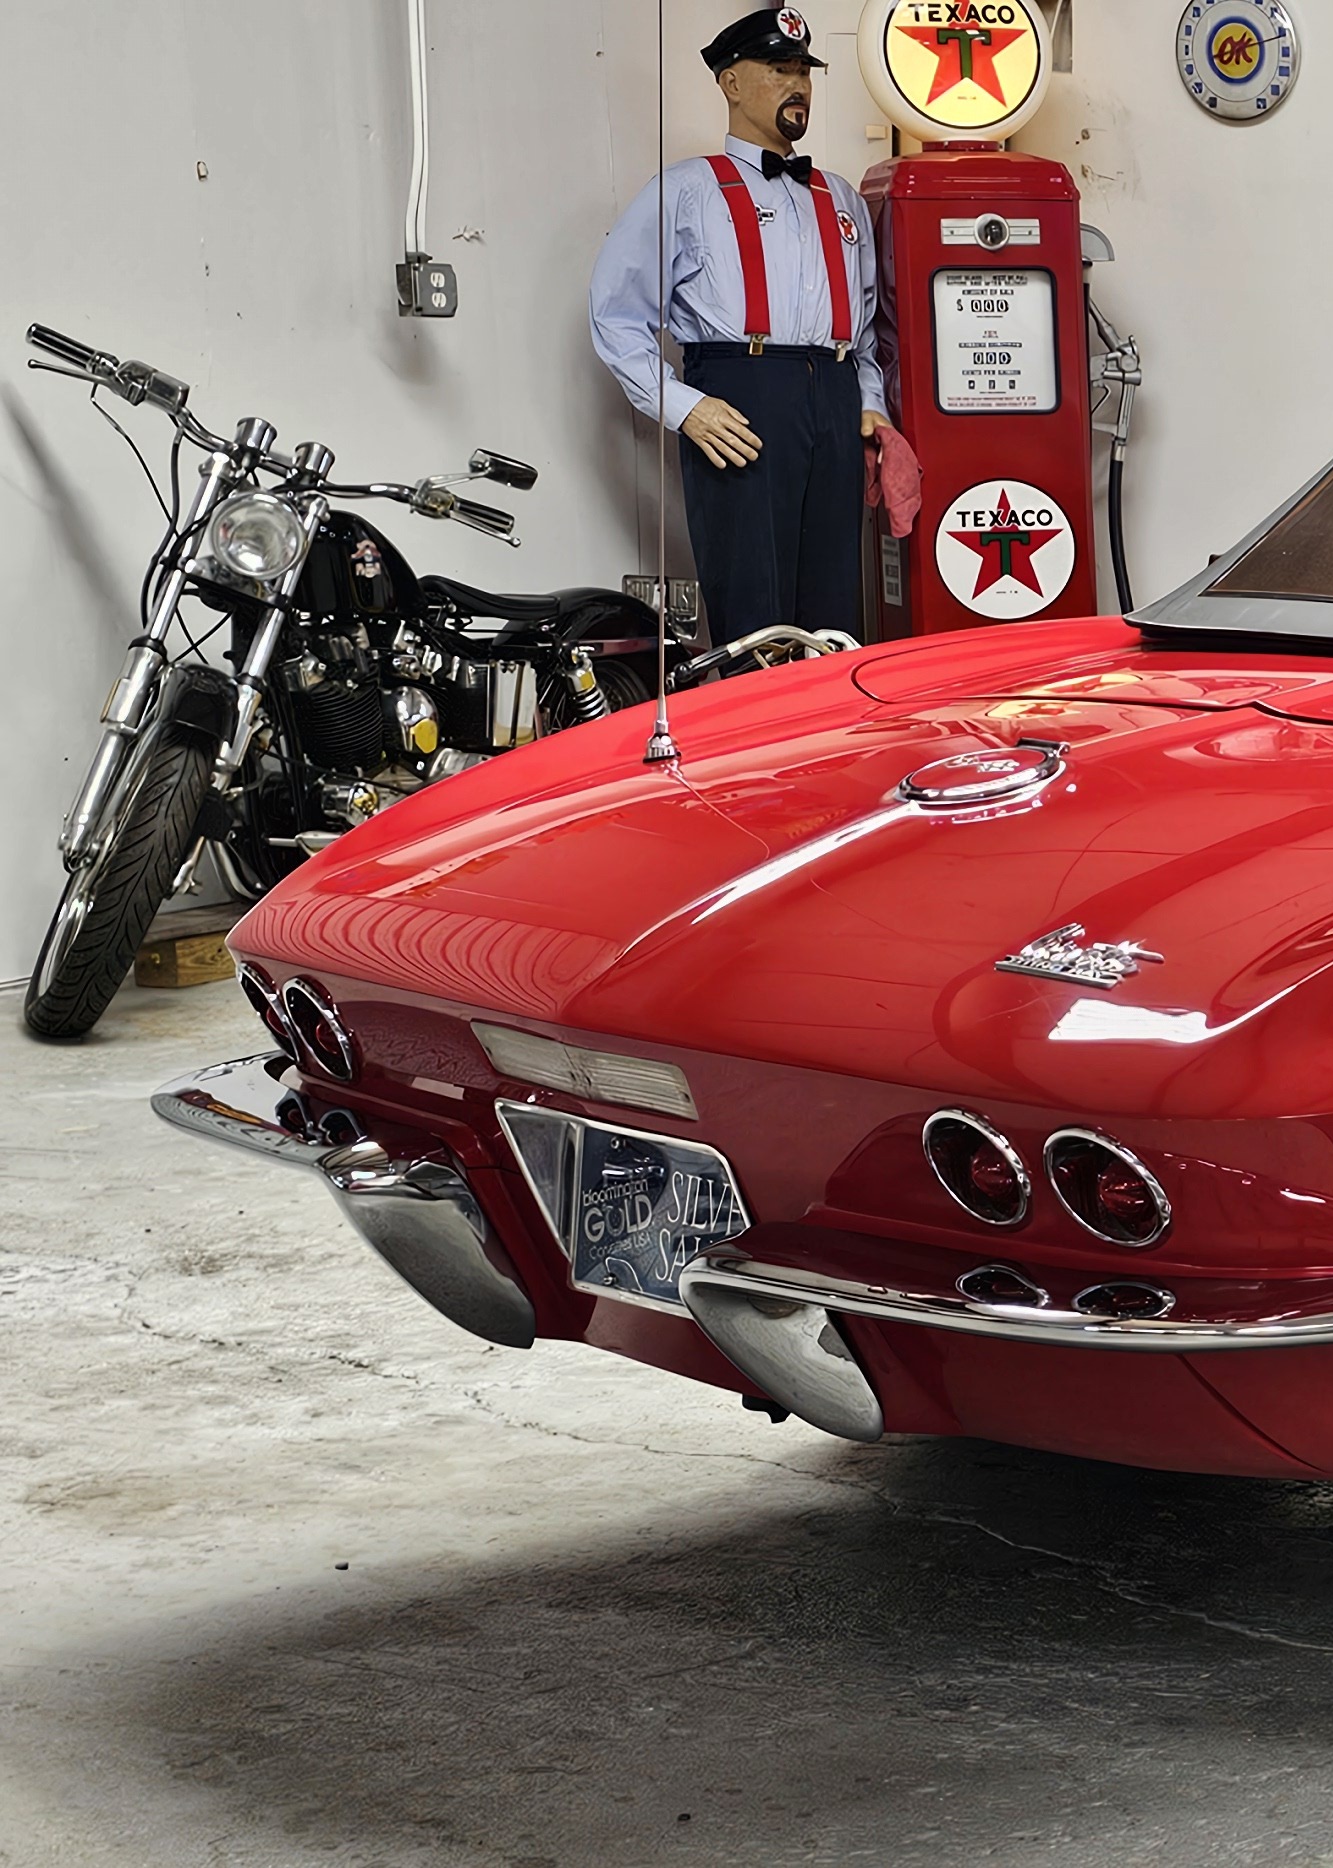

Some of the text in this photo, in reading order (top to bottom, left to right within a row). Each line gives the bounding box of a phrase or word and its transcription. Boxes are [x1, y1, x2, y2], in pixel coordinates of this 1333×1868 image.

[907, 4, 1015, 24] TEXACO
[1217, 32, 1253, 65] OK
[956, 509, 1053, 527] TEXACO
[582, 1179, 649, 1206] bloomington
[585, 1194, 652, 1242] GOLD
